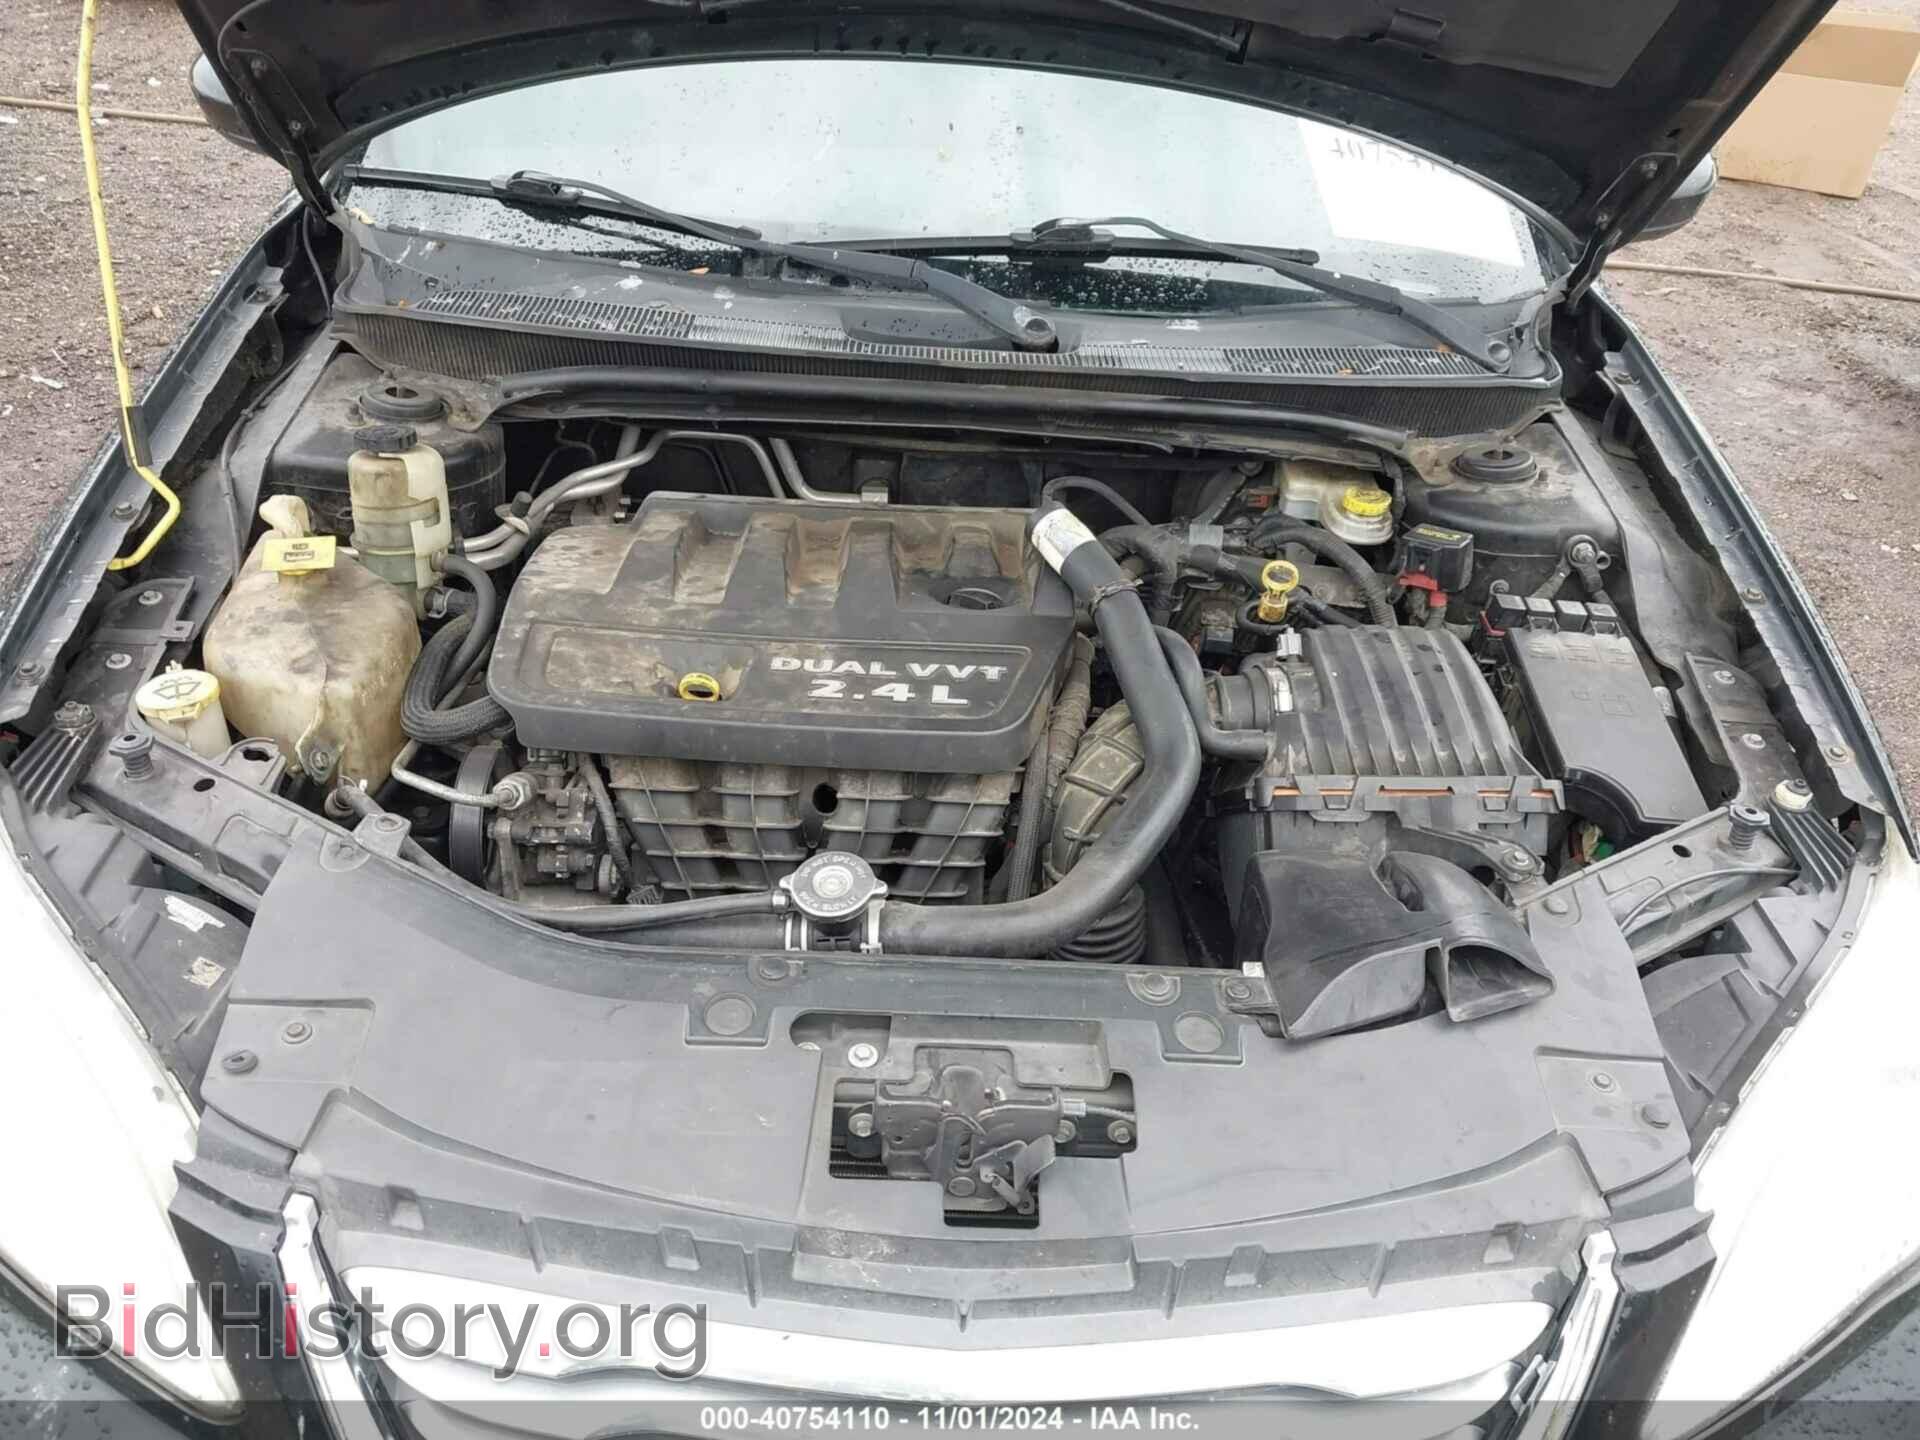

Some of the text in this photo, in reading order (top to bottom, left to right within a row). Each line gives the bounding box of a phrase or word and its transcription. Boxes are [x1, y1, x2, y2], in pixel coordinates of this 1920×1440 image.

[769, 656, 1008, 681] DUAL VVT
[807, 678, 969, 705] 2.4 L
